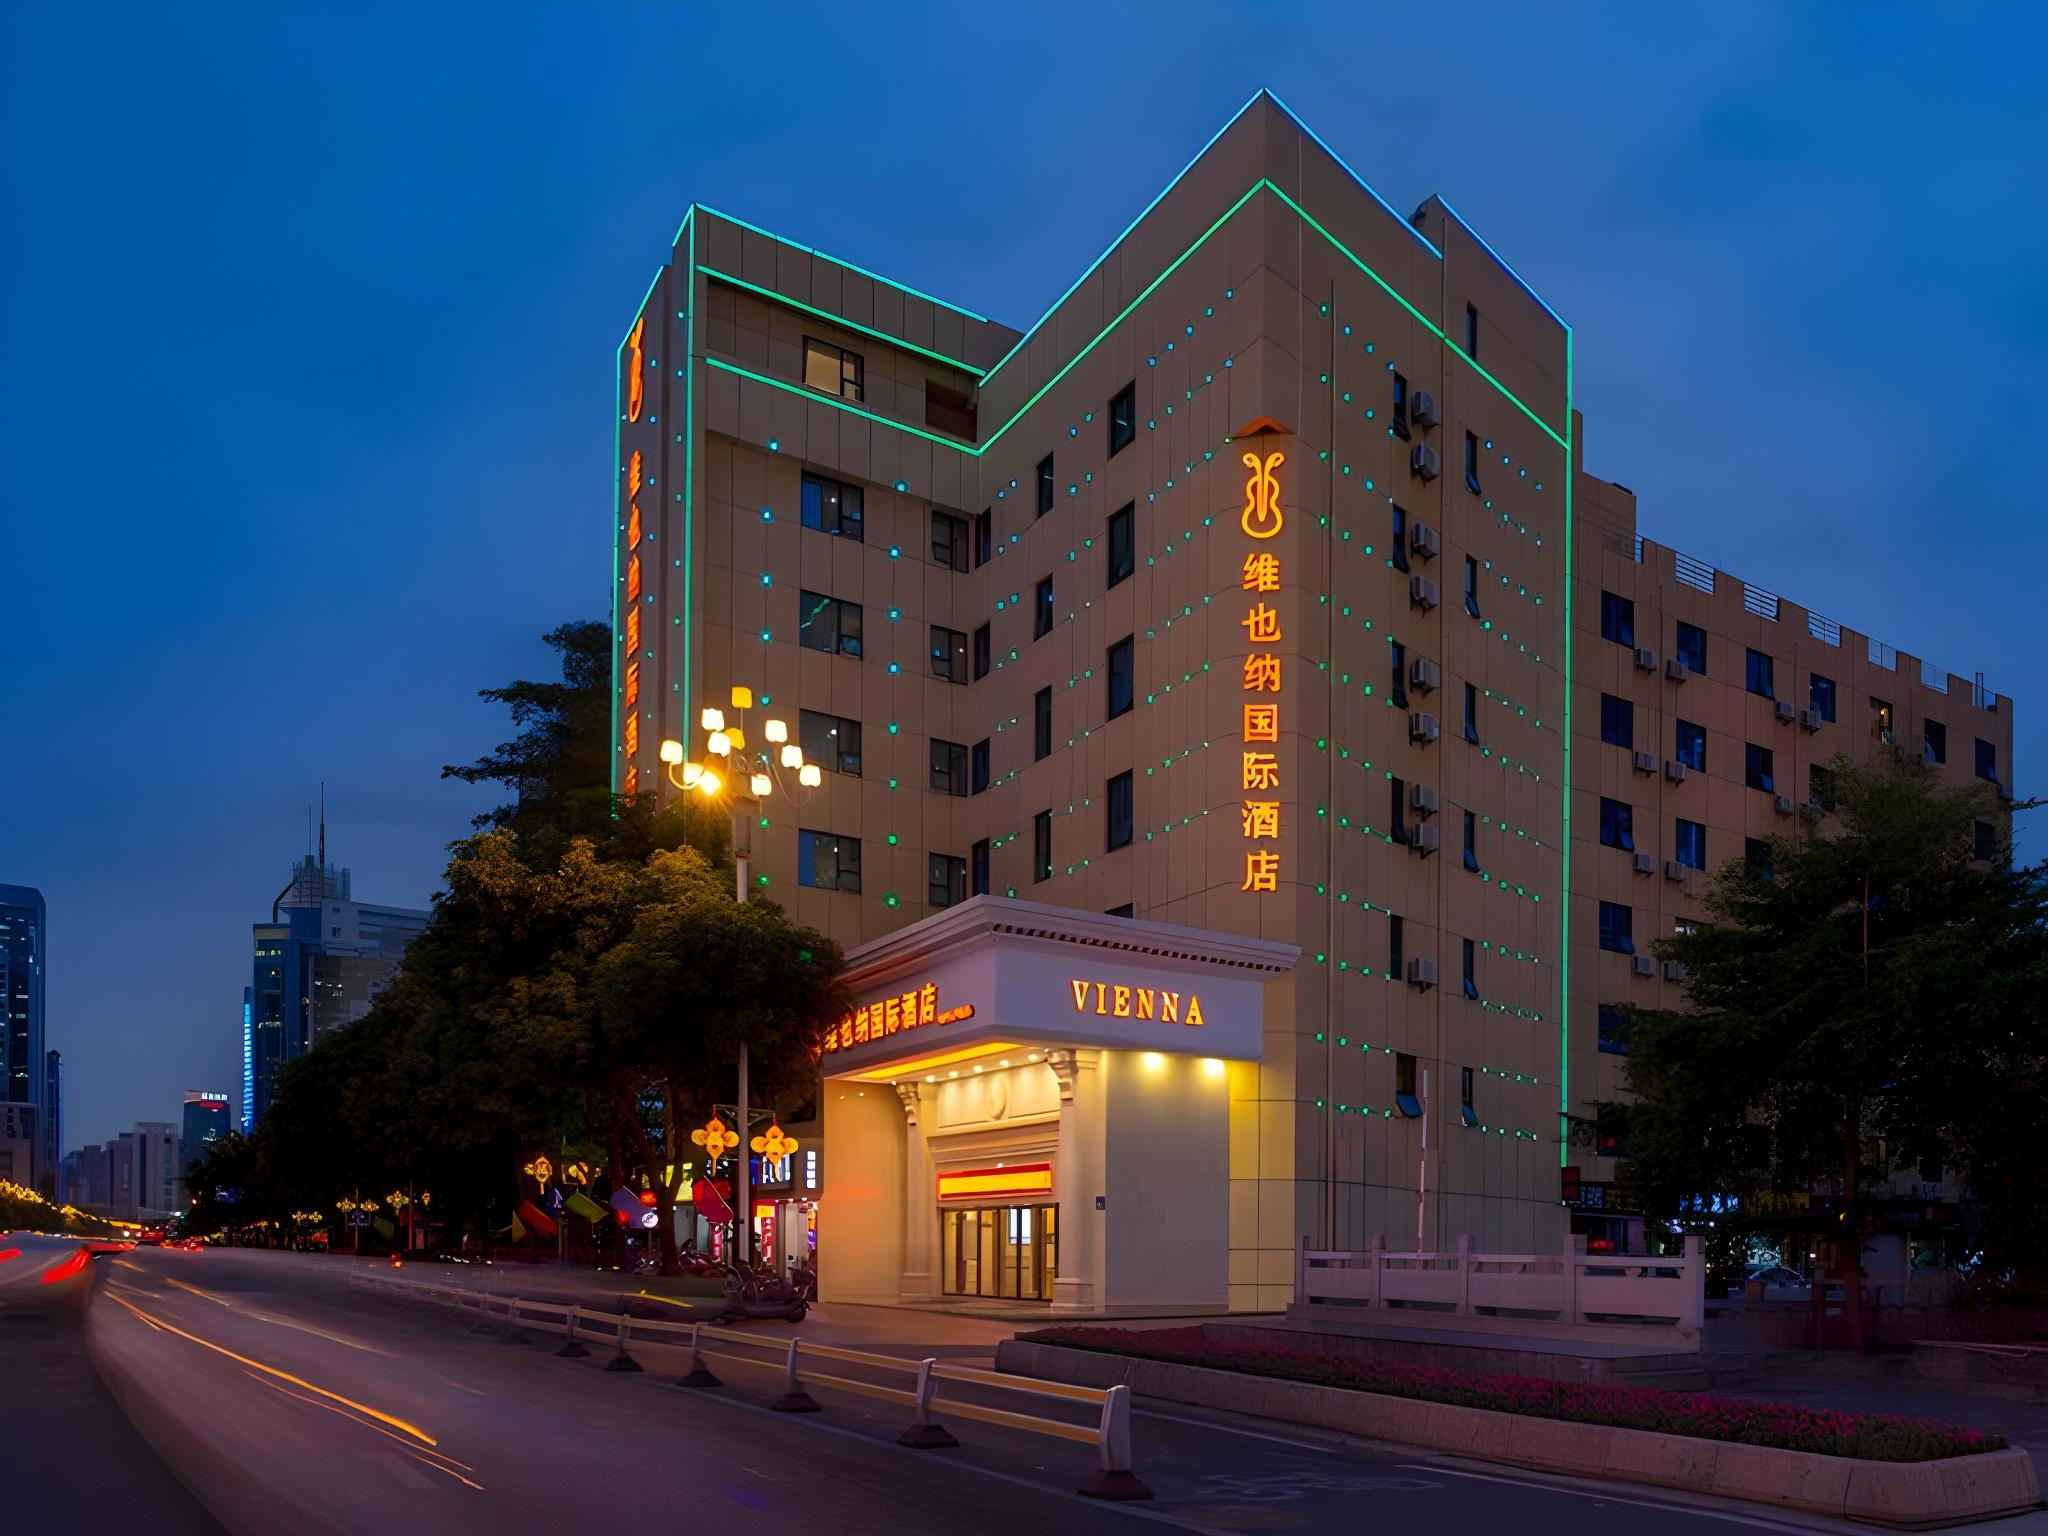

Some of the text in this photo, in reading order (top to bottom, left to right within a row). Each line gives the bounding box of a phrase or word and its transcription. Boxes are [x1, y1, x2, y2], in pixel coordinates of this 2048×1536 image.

[1241, 552, 1282, 893] 维也纳国际酒店
[1071, 979, 1204, 1026] VIENNA
